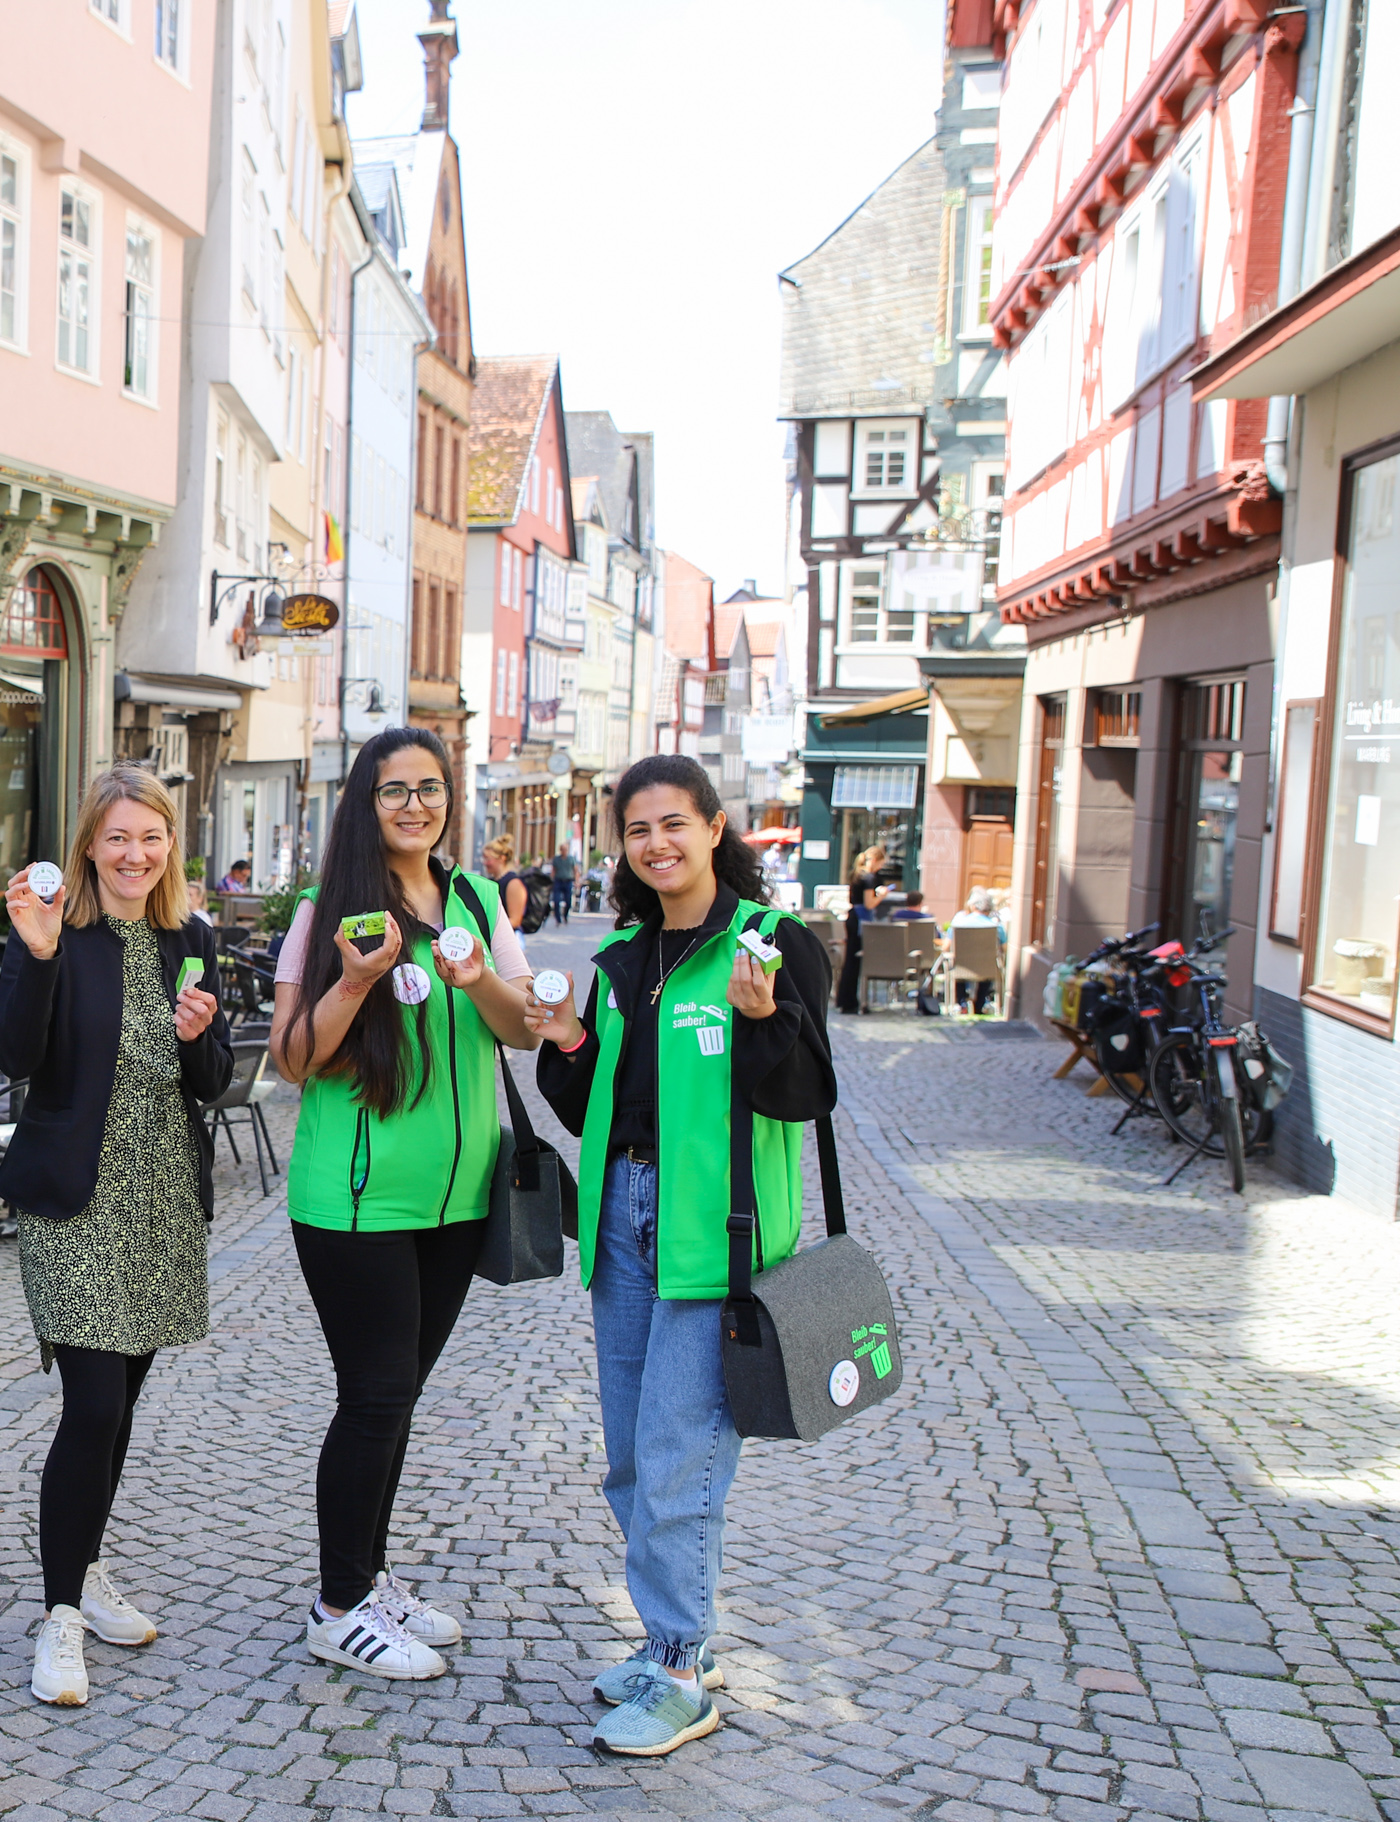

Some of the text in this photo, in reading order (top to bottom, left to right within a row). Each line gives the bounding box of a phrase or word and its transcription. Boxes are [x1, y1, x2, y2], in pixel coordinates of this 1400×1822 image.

[673, 1001, 697, 1014] Bleib
[672, 1014, 707, 1029] sauber!
[851, 1324, 868, 1344] Bleib
[853, 1336, 877, 1359] sauber!
